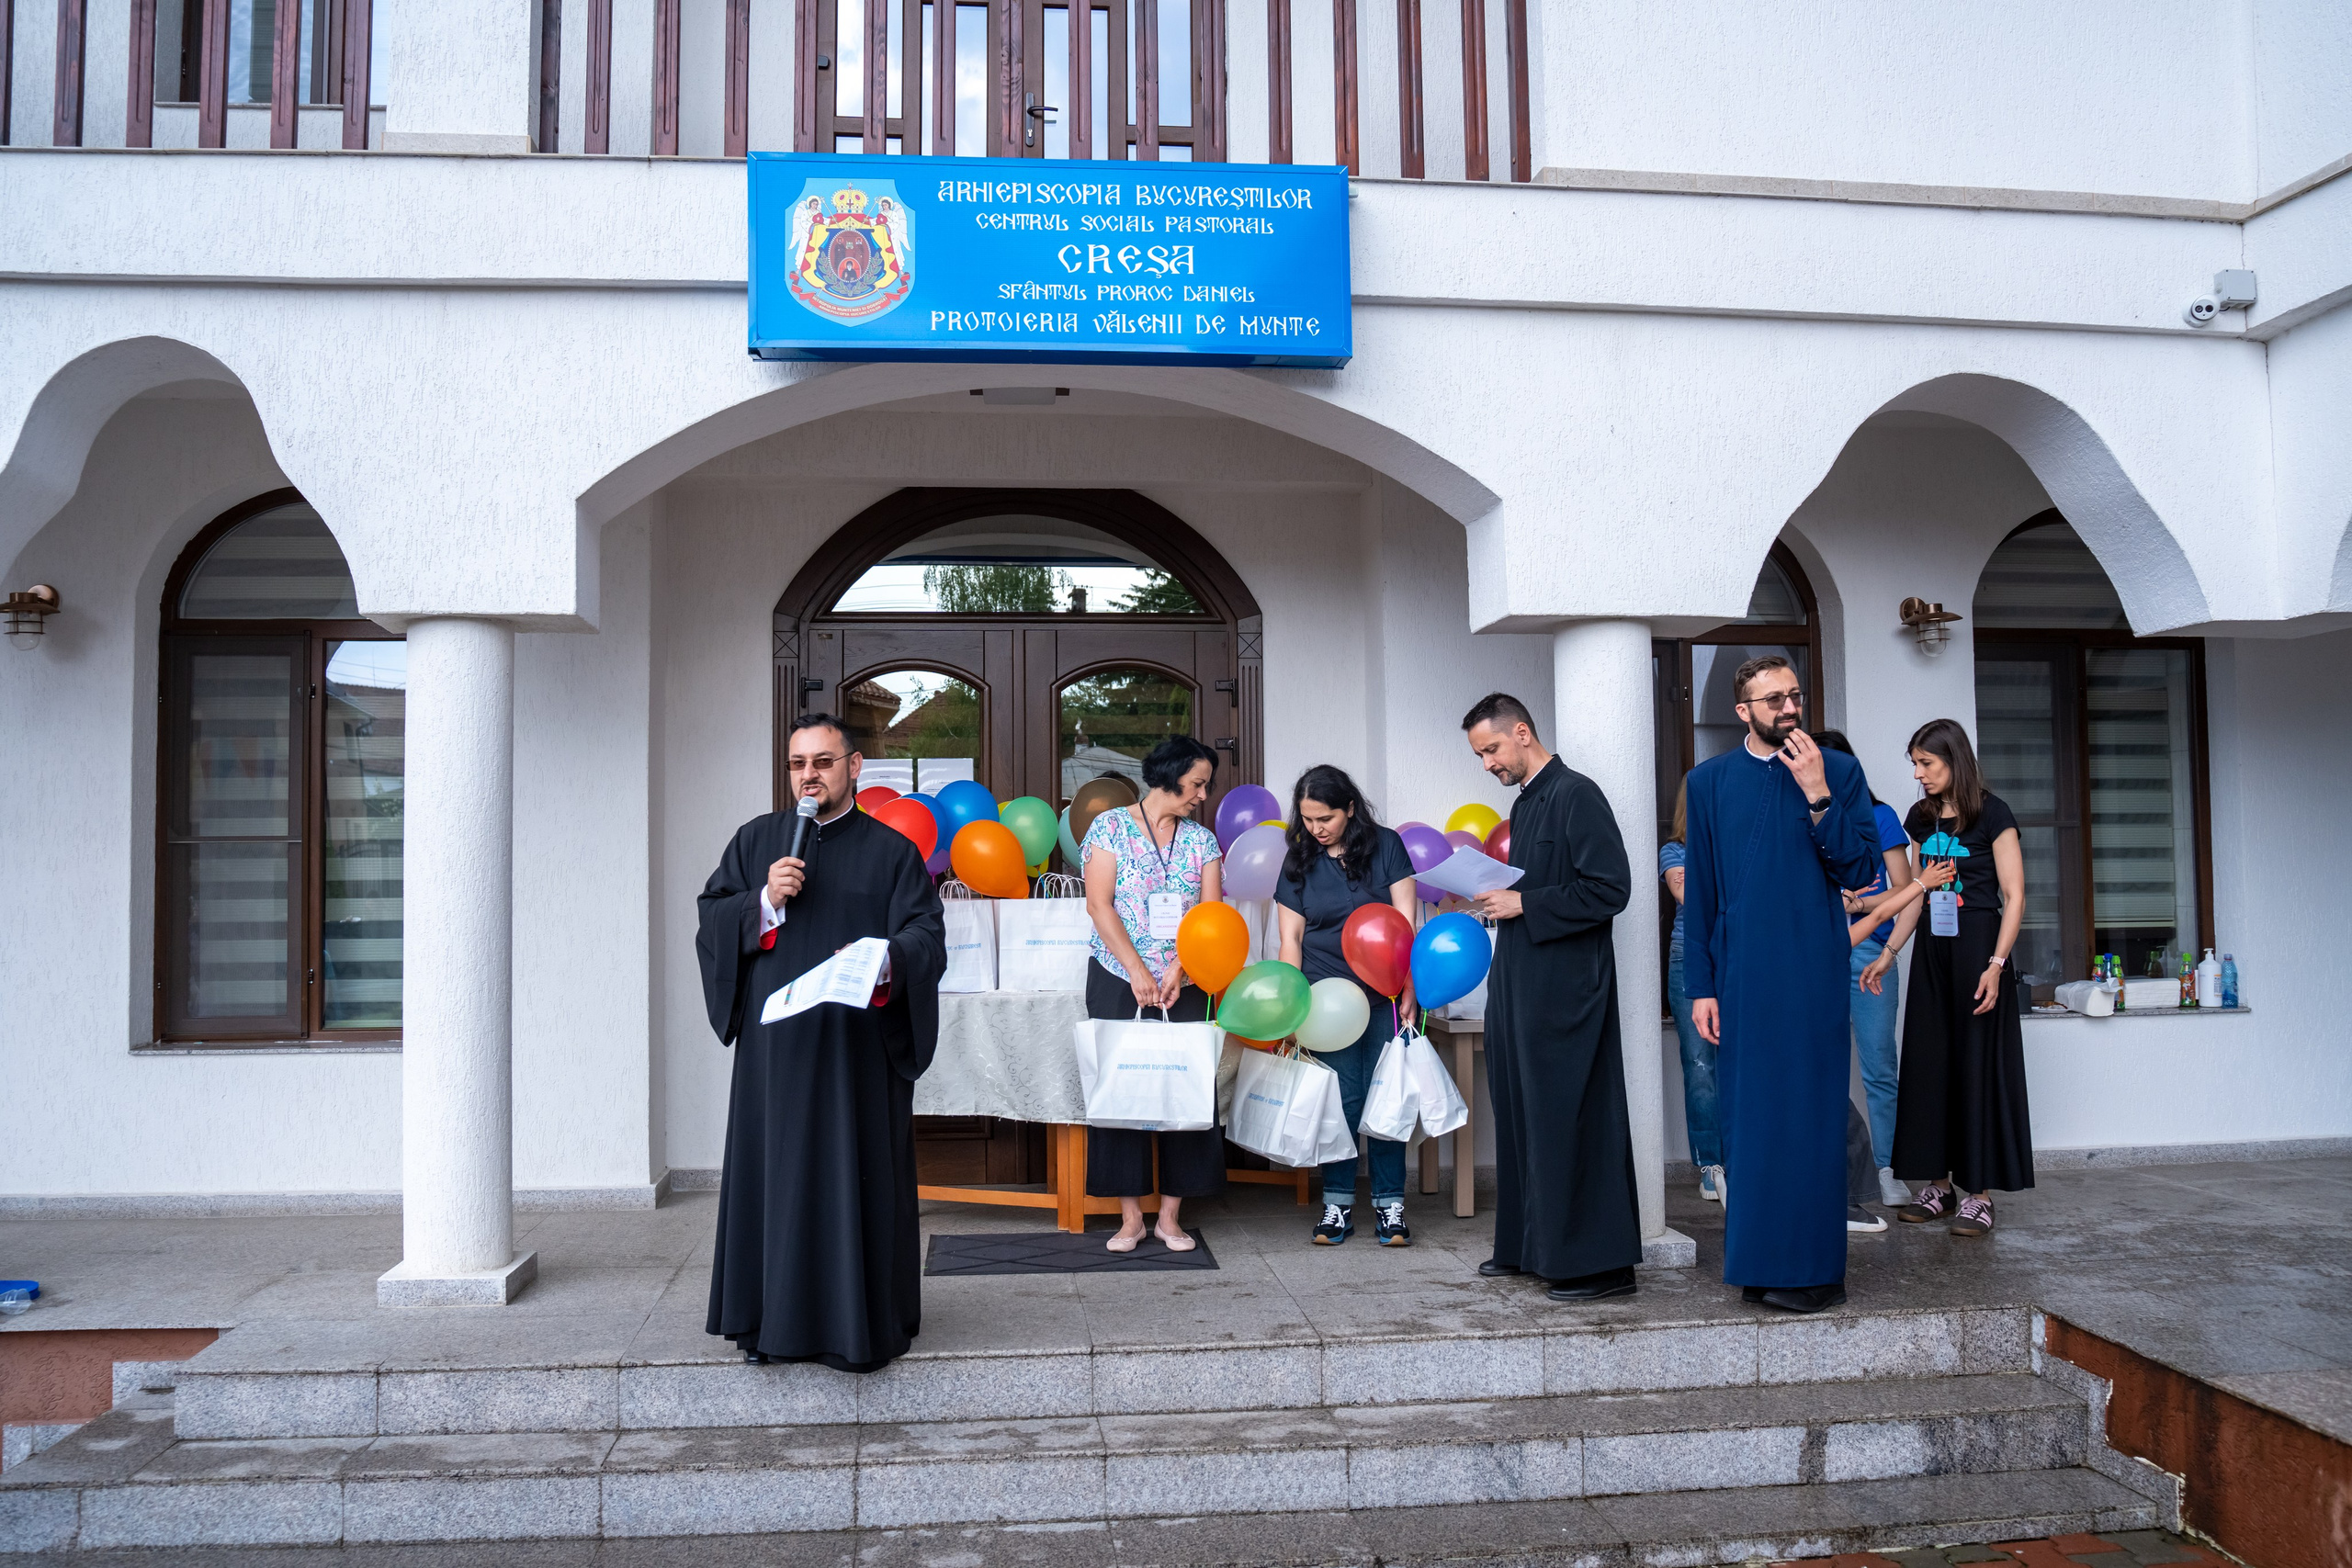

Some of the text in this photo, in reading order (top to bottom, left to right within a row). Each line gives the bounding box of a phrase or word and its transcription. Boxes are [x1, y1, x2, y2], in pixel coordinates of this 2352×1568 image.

[937, 180, 1121, 206] ARHIEPISCOPIA
[976, 212, 1274, 234] CENTRUL SOCIAL PASTORAL
[998, 280, 1255, 303] SFÂNTUL PROROC DANIEL
[931, 310, 1320, 336] PROTOIERIA VĂLENII DE MUNTE
